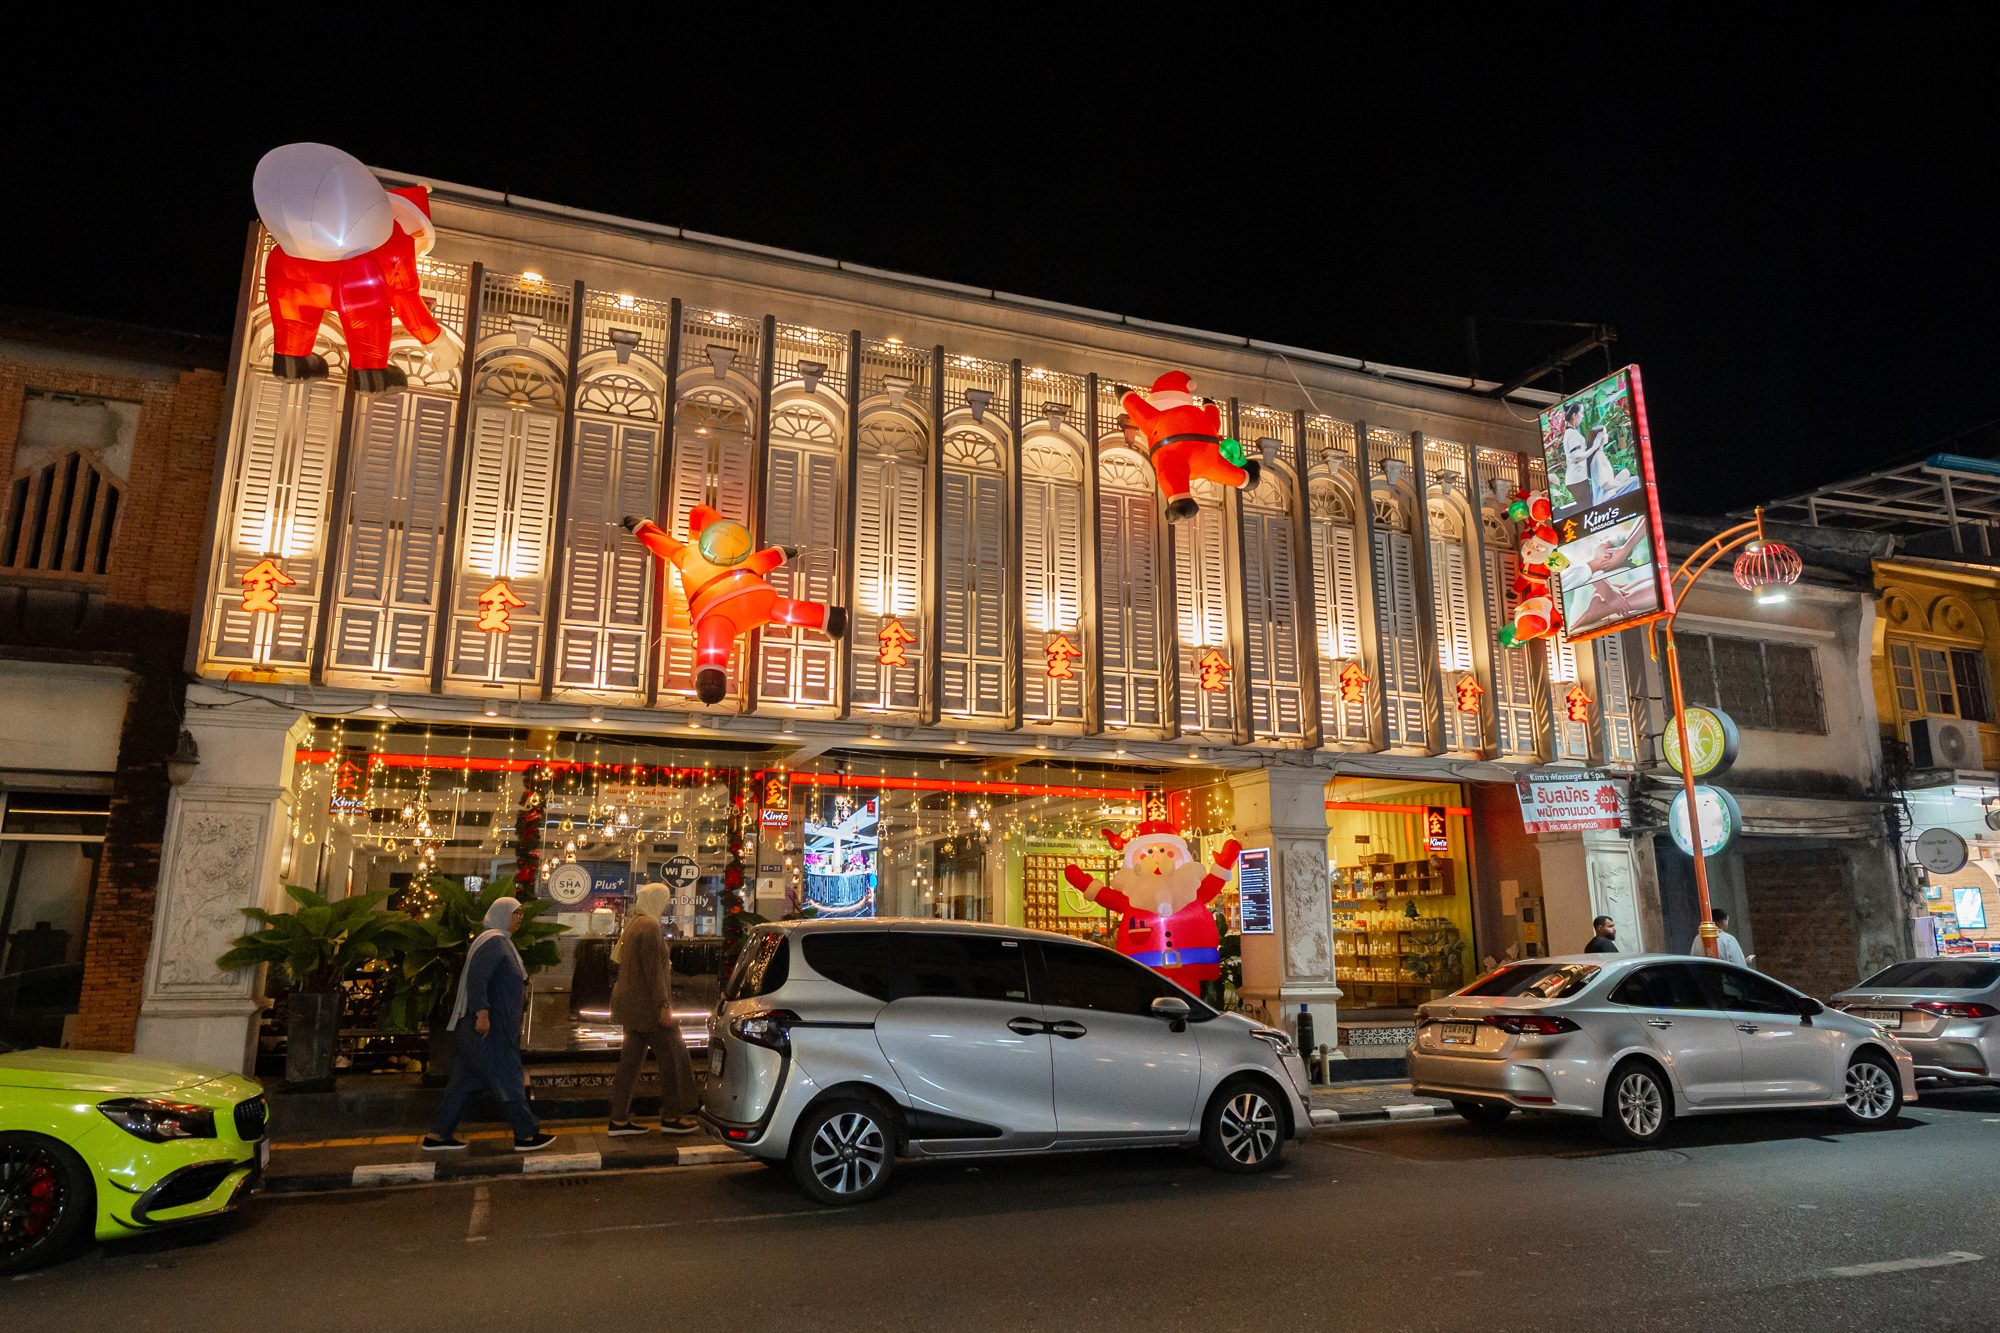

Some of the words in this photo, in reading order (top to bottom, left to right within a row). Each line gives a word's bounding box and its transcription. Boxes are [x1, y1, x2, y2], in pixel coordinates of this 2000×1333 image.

[1584, 507, 1619, 529] Kim's
[1590, 519, 1615, 533] MASSAGE
[1563, 519, 1578, 543] 金
[241, 559, 296, 613] 金
[479, 582, 526, 633] 金
[879, 619, 917, 666] 金
[1047, 634, 1082, 679] 金
[1200, 649, 1232, 691] 金
[1340, 662, 1371, 703] 金
[1456, 674, 1485, 714] 金
[1566, 685, 1593, 722] 金
[1529, 773, 1549, 781] Kim's
[1551, 773, 1582, 781] Massage
[1590, 771, 1605, 780] Spa
[765, 778, 788, 805] 金
[1537, 785, 1590, 803] รับสมัคร
[1600, 794, 1615, 803] ด่วน
[762, 810, 788, 820] Kim's
[1536, 805, 1596, 818] พนักงานนวด
[1429, 812, 1444, 834] 金
[1430, 837, 1447, 847] Kim's
[665, 867, 678, 875] Wi
[681, 895, 709, 907] Daily
